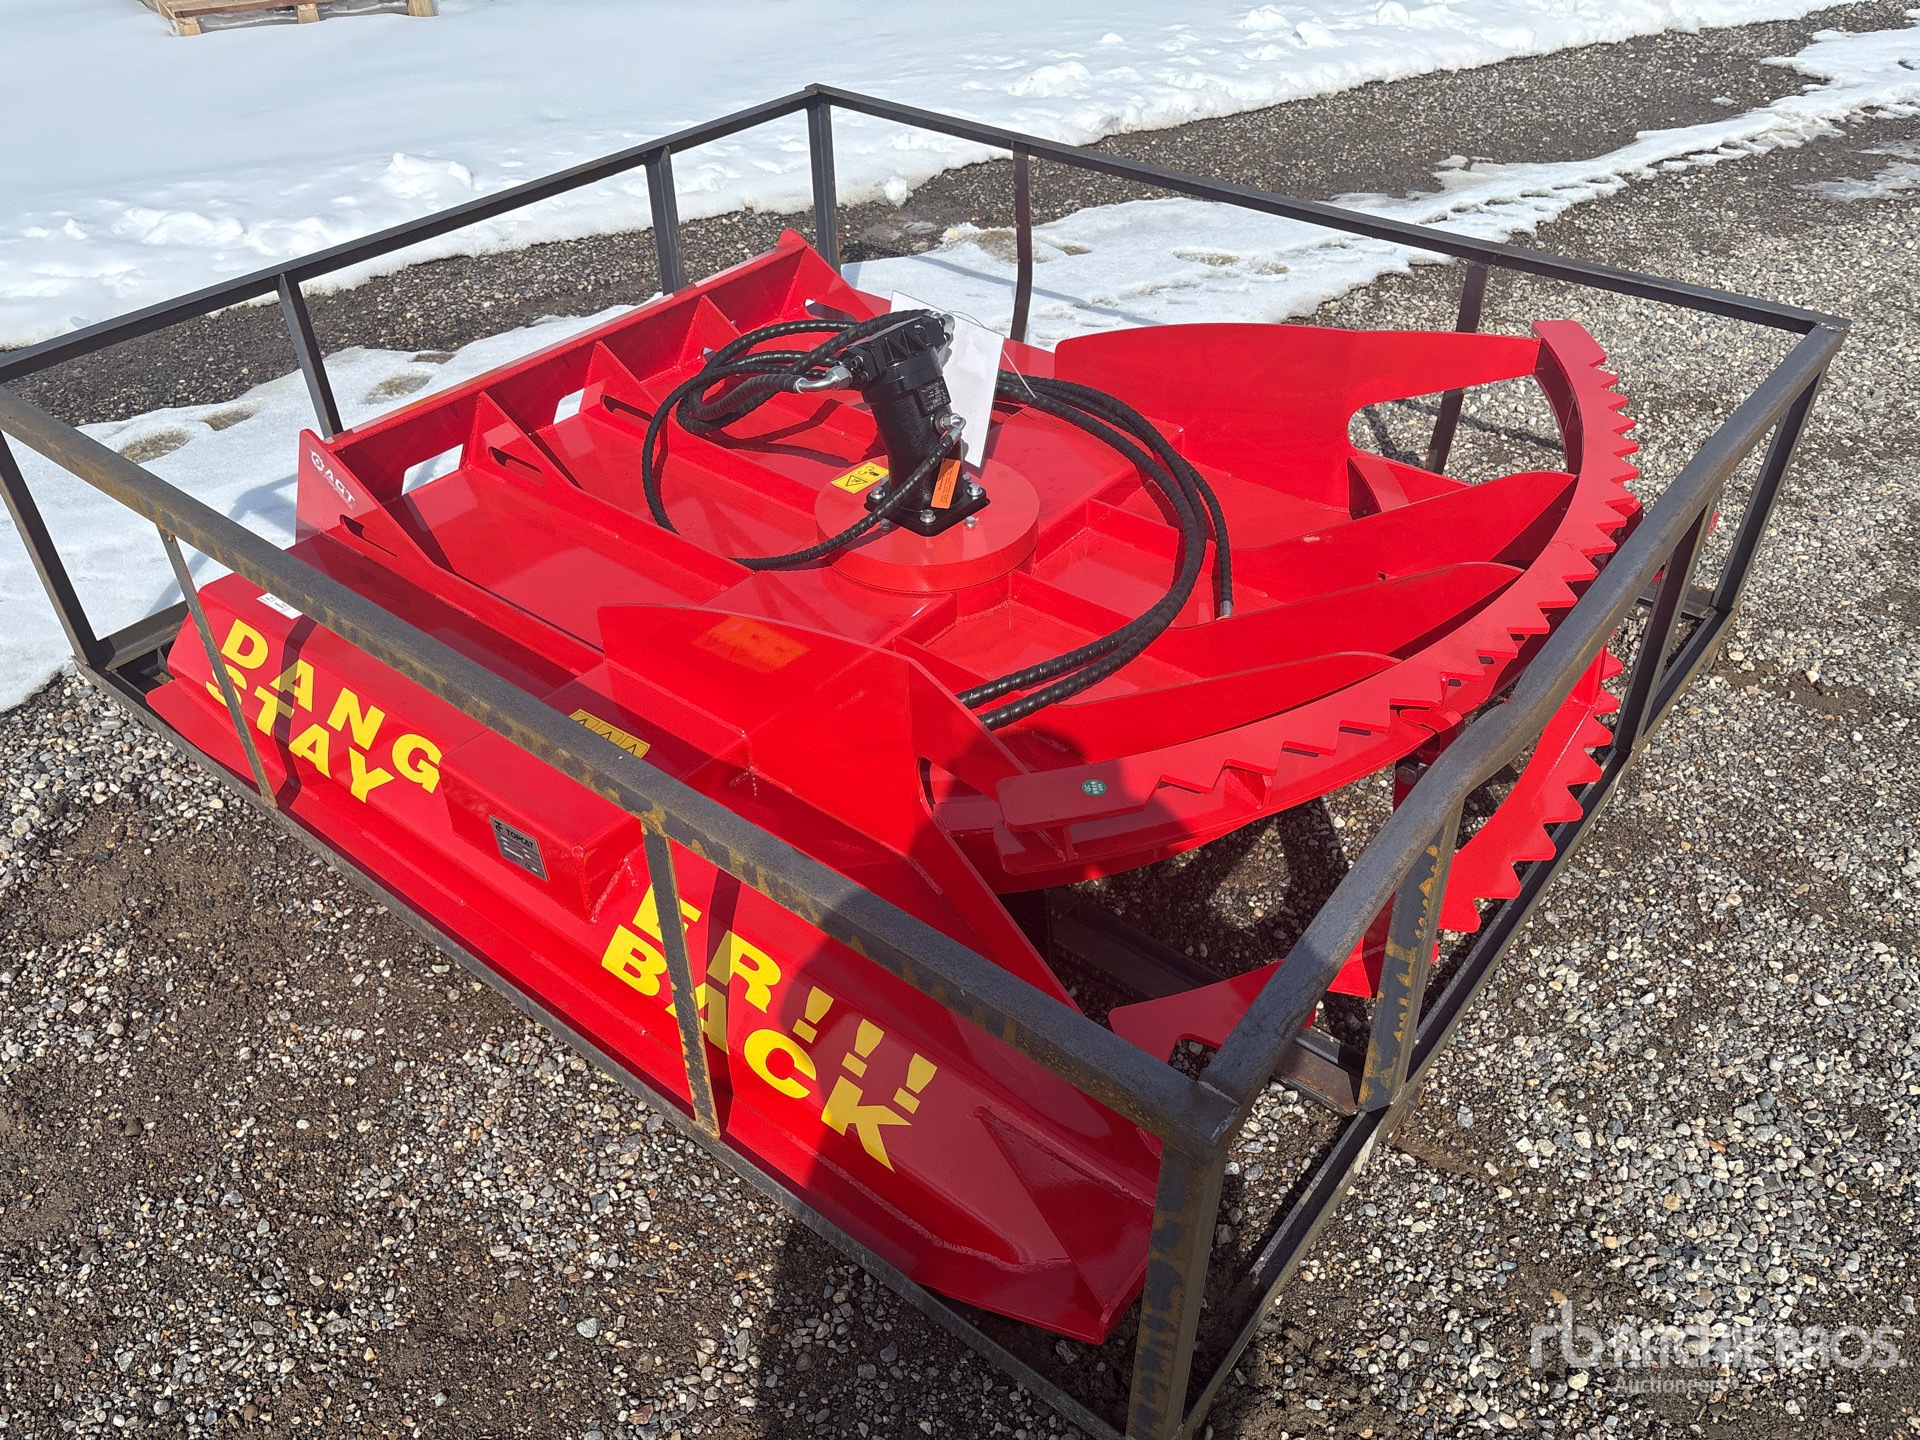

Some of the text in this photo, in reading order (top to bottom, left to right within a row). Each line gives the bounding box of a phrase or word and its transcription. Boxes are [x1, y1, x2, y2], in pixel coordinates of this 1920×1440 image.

[206, 664, 395, 804] STAY
[220, 618, 443, 794] DANG
[505, 828, 534, 849] TOPCAT
[601, 924, 912, 1173] BACK
